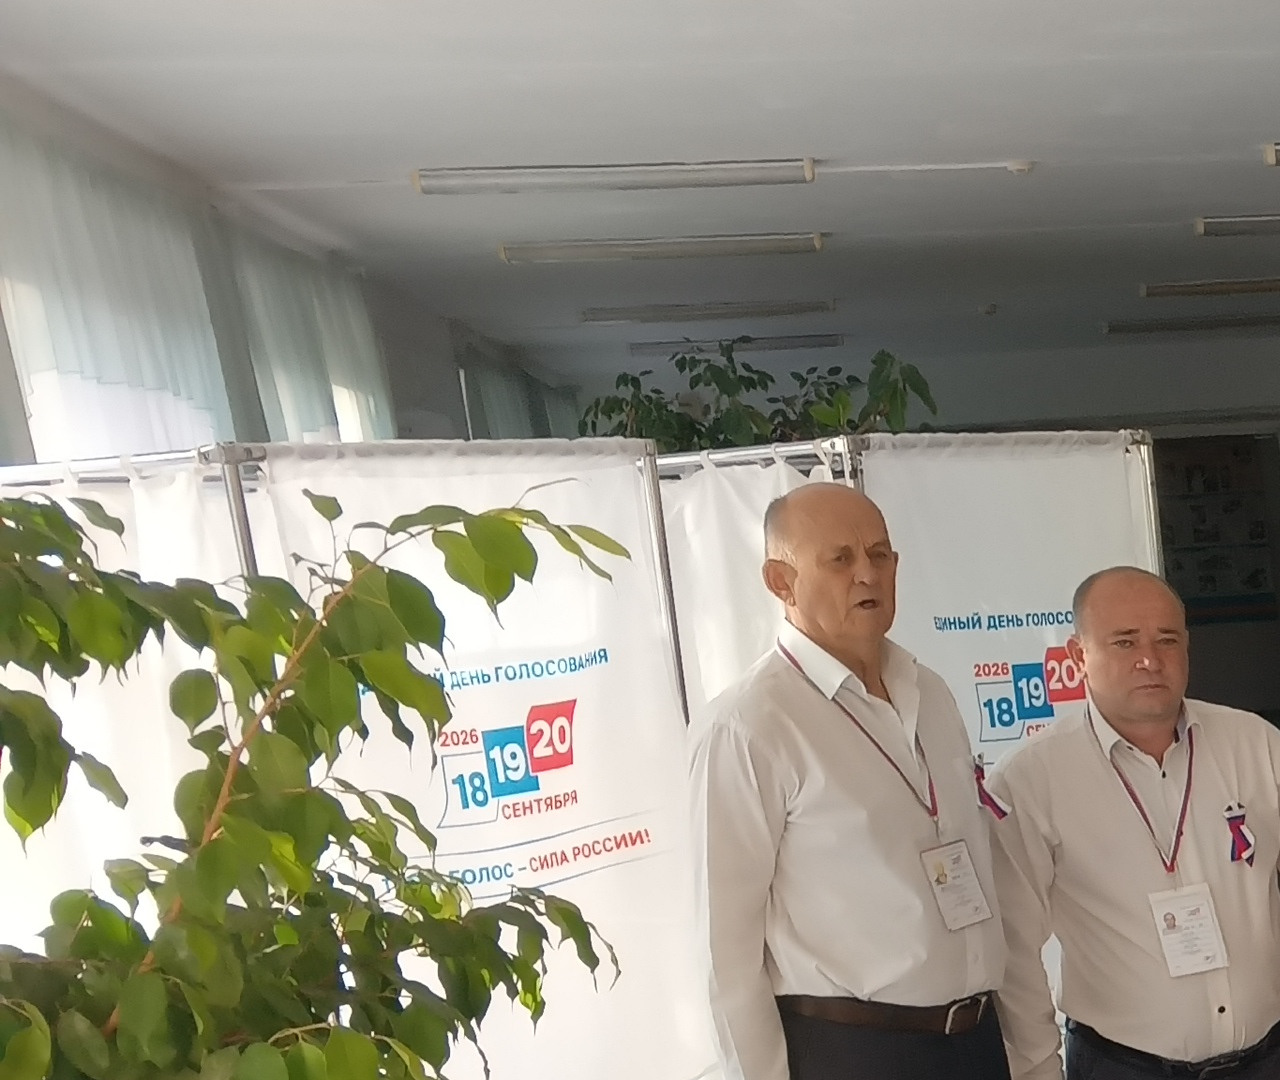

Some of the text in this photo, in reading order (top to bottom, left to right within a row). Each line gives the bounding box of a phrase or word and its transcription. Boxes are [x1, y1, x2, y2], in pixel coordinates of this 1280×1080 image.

[986, 614, 1024, 631] ДЕНЬ
[1025, 611, 1074, 627] ГОЛОСО
[450, 666, 492, 690] ДЕНЬ
[494, 648, 609, 683] ГОЛОСОВАНИЯ
[973, 662, 1010, 677] 2026
[983, 658, 1081, 728] 18 19 20
[439, 729, 479, 747] 2026
[451, 715, 573, 810] 18 19 20
[501, 790, 579, 820] СЕНТЯБРЯ
[529, 850, 569, 873] СИЛА
[572, 828, 652, 862] РОССИИ!
